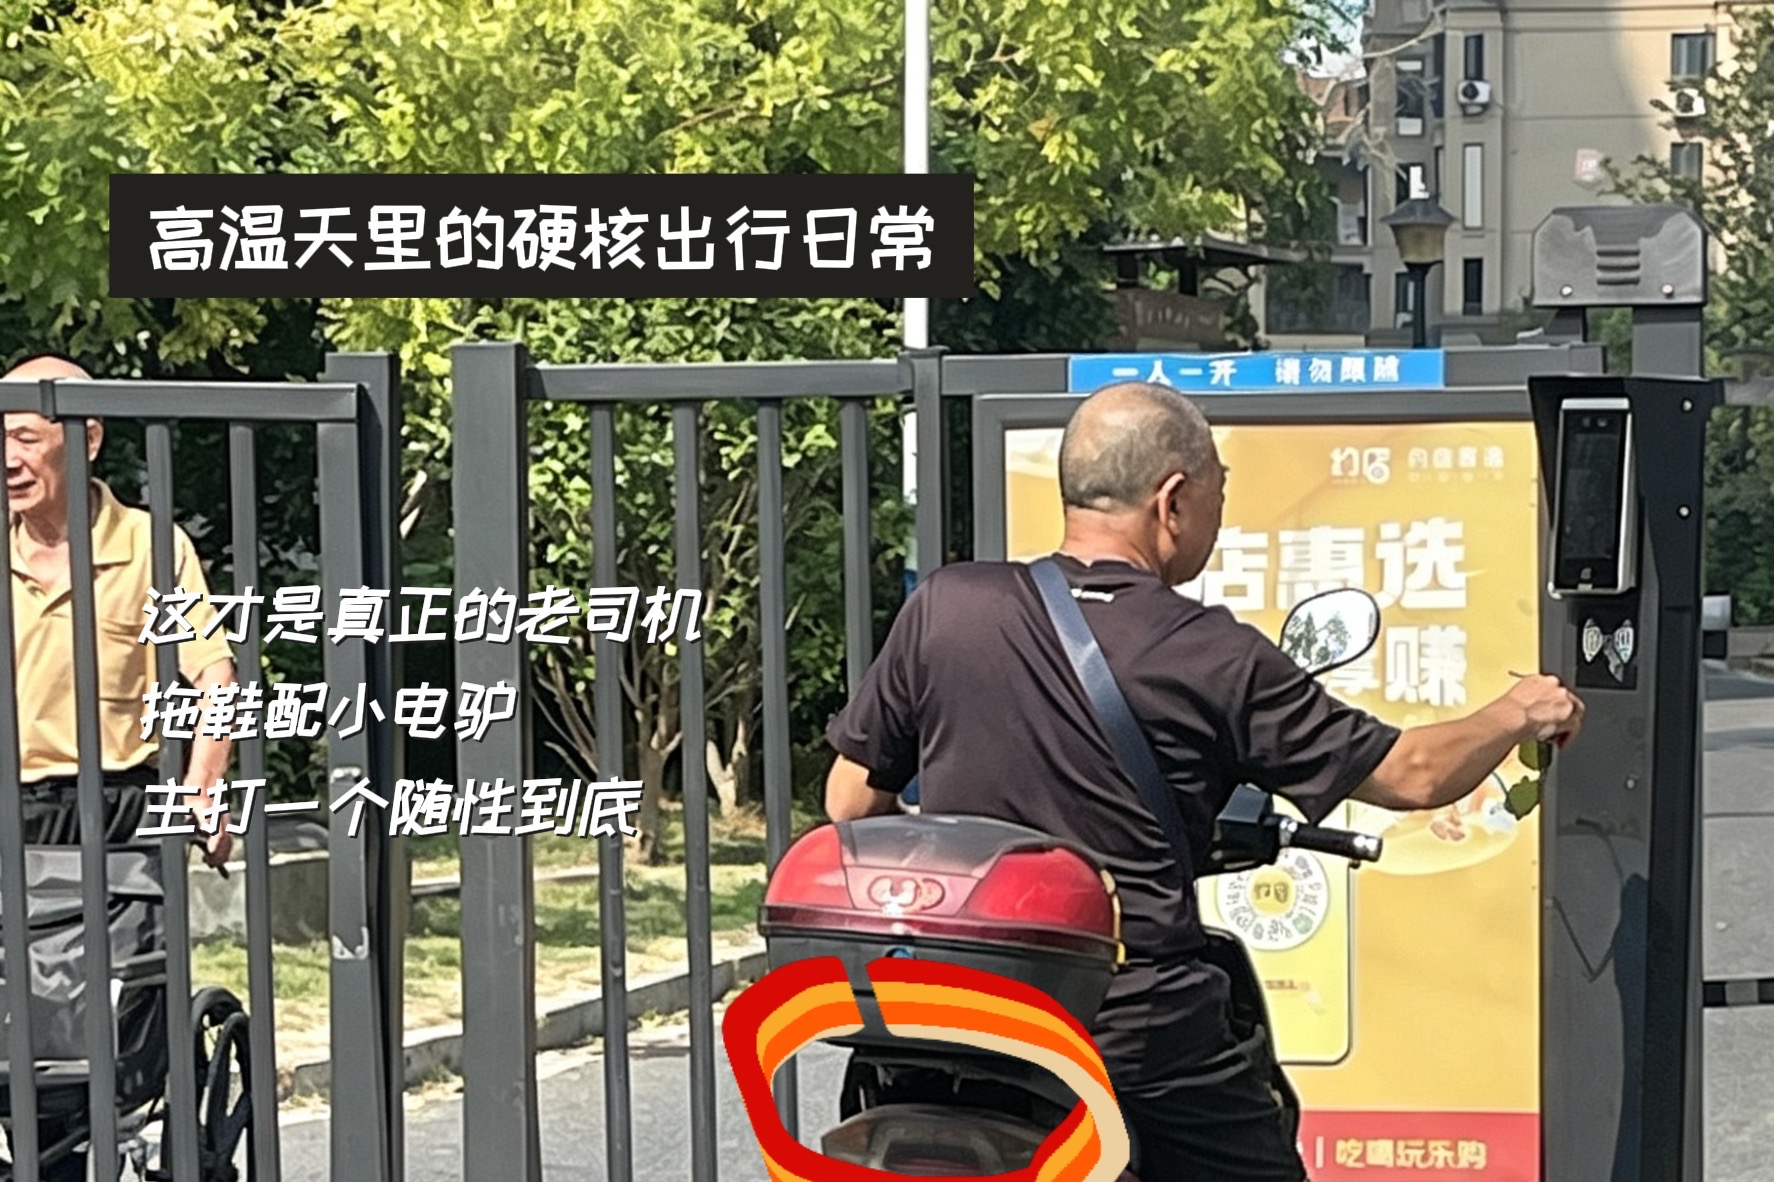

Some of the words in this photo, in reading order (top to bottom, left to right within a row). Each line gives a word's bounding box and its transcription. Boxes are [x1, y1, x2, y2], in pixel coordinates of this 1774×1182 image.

[1112, 359, 1237, 386] 一人一开
[1335, 1138, 1487, 1170] 吃喝玩乐购
